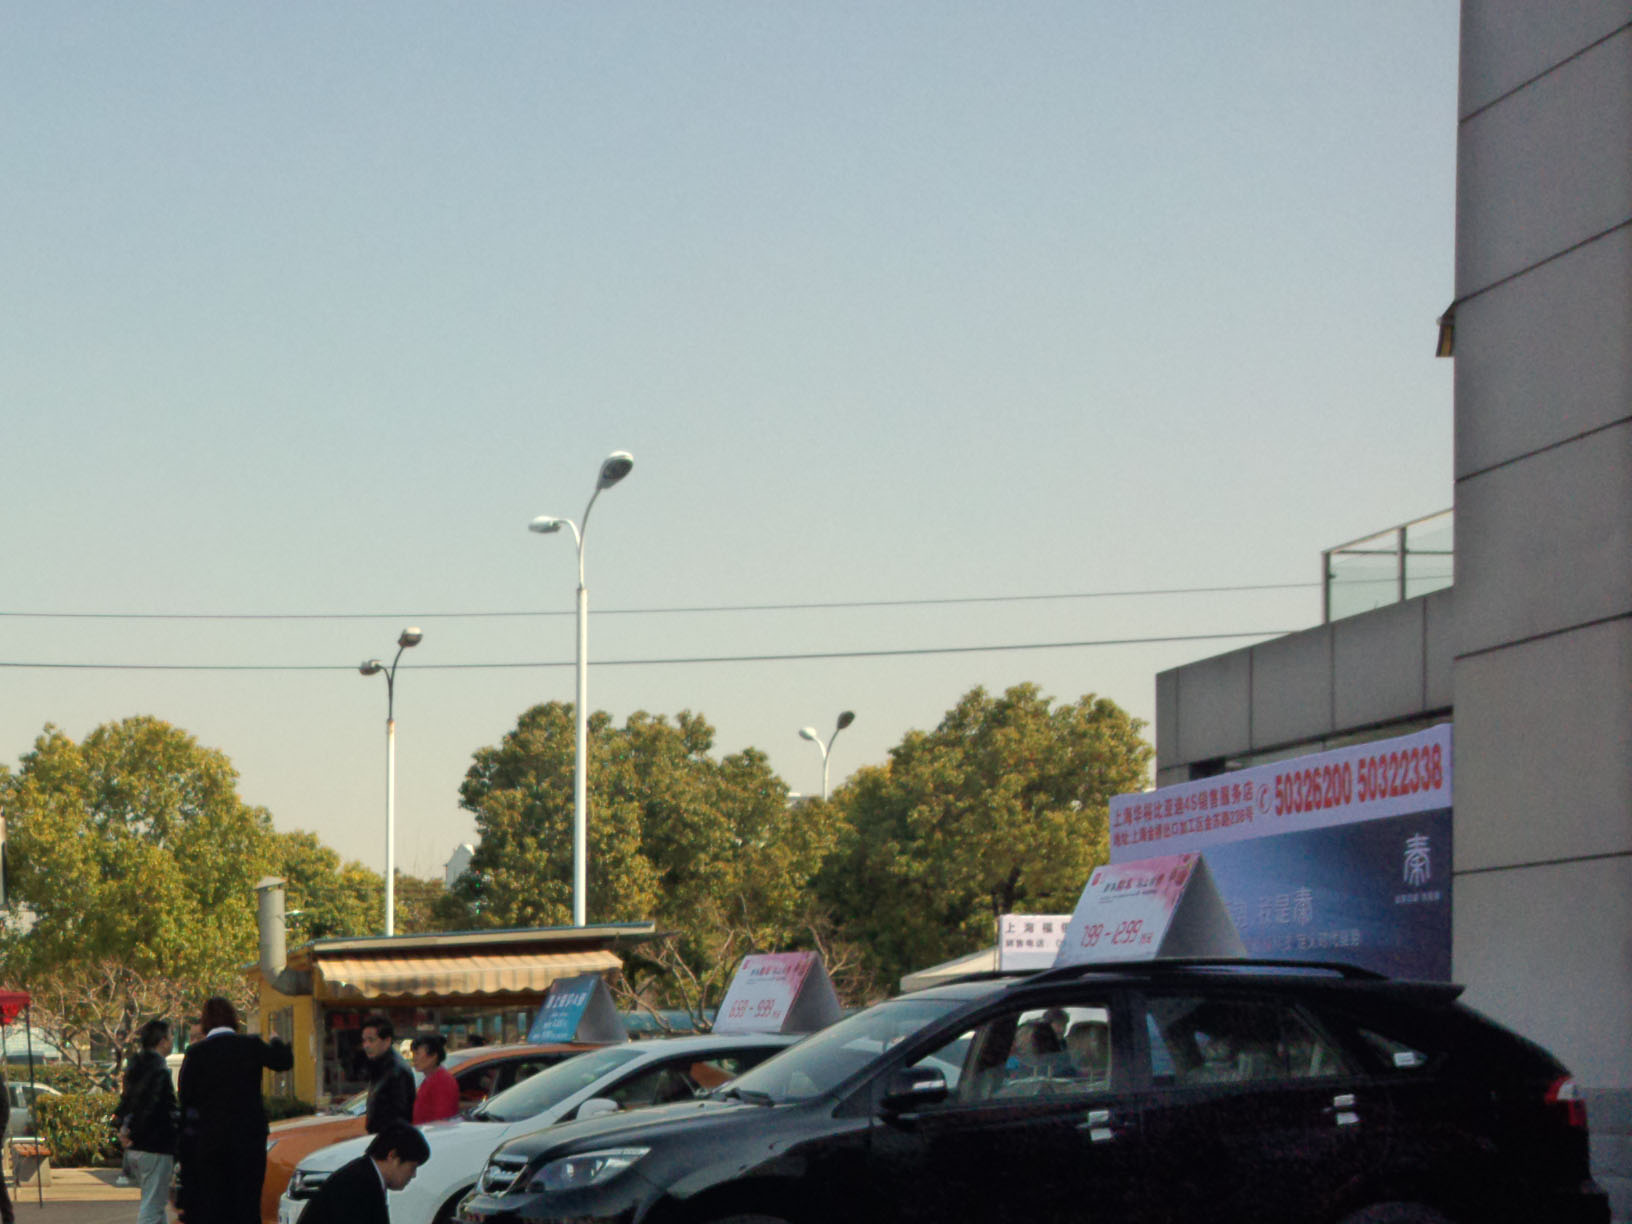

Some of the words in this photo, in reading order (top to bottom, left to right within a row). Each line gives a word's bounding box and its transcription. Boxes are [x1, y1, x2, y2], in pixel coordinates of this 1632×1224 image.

[1275, 762, 1352, 816] 50326200
[1357, 743, 1442, 802] 50322338
[1404, 833, 1431, 887] 秦
